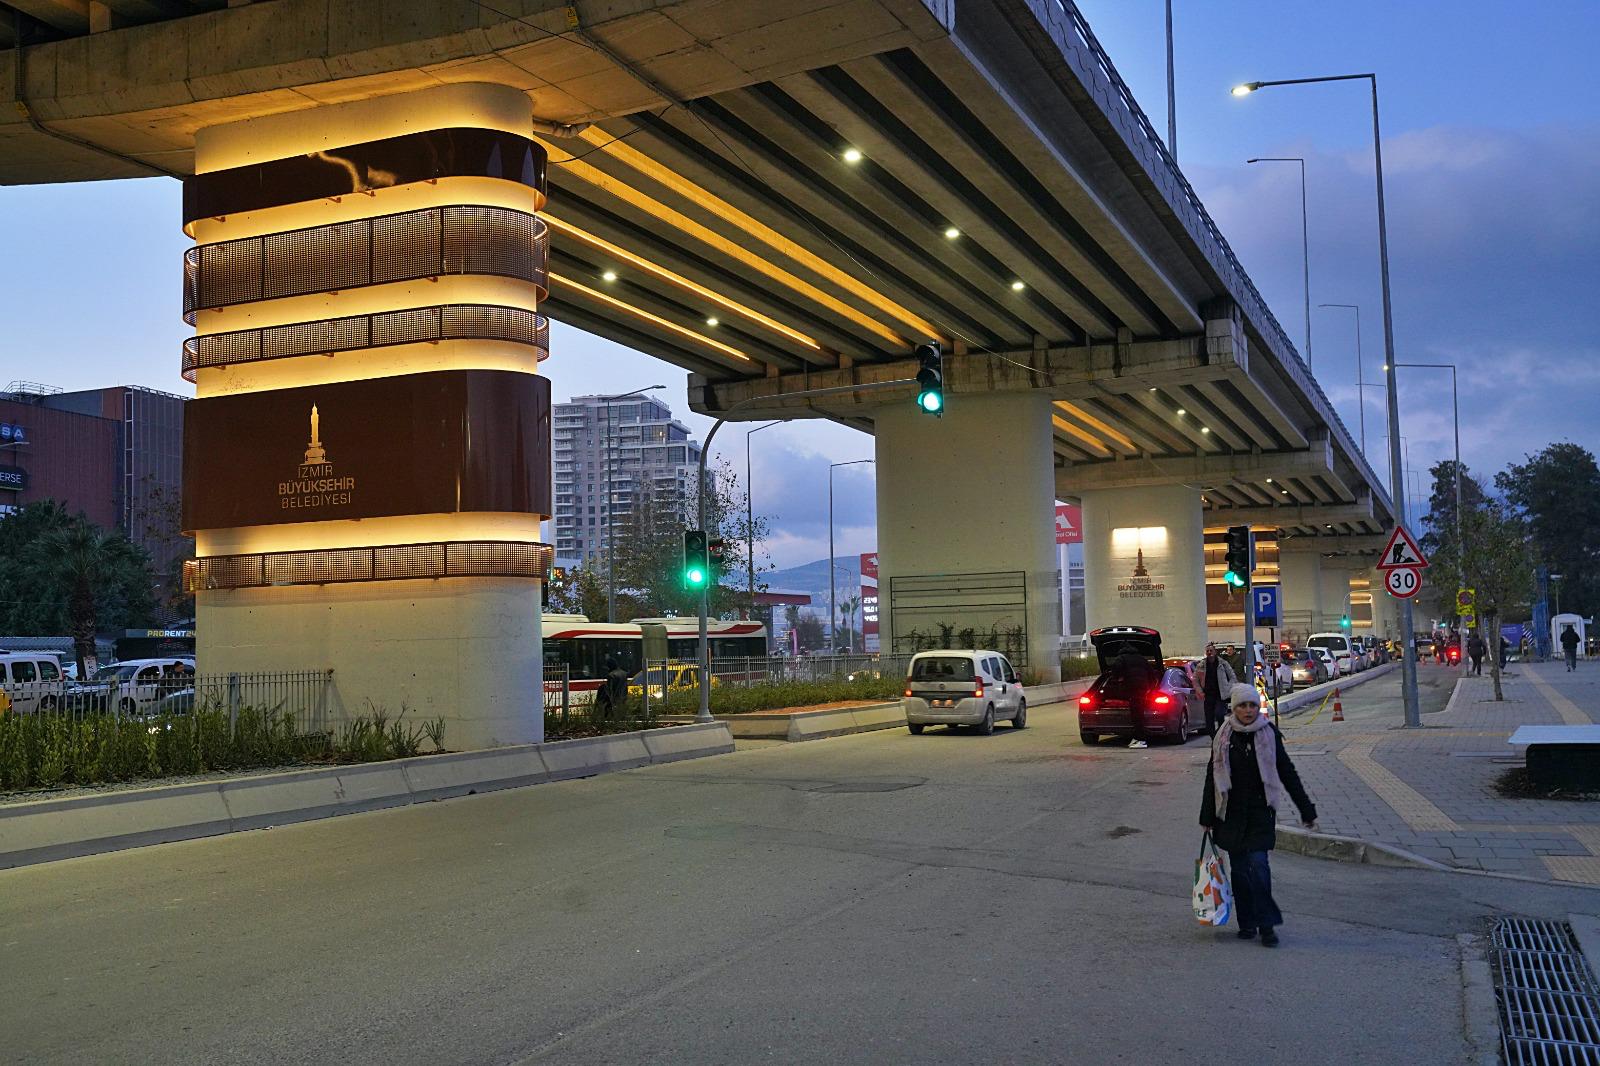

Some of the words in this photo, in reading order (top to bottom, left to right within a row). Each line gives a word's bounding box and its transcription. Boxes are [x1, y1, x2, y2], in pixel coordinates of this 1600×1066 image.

[298, 464, 333, 478] İZMİR
[278, 476, 355, 495] BÜYÜKŞEHİR
[281, 492, 351, 508] BELEDİYESİ
[1392, 573, 1414, 588] 30
[1258, 592, 1271, 612] P
